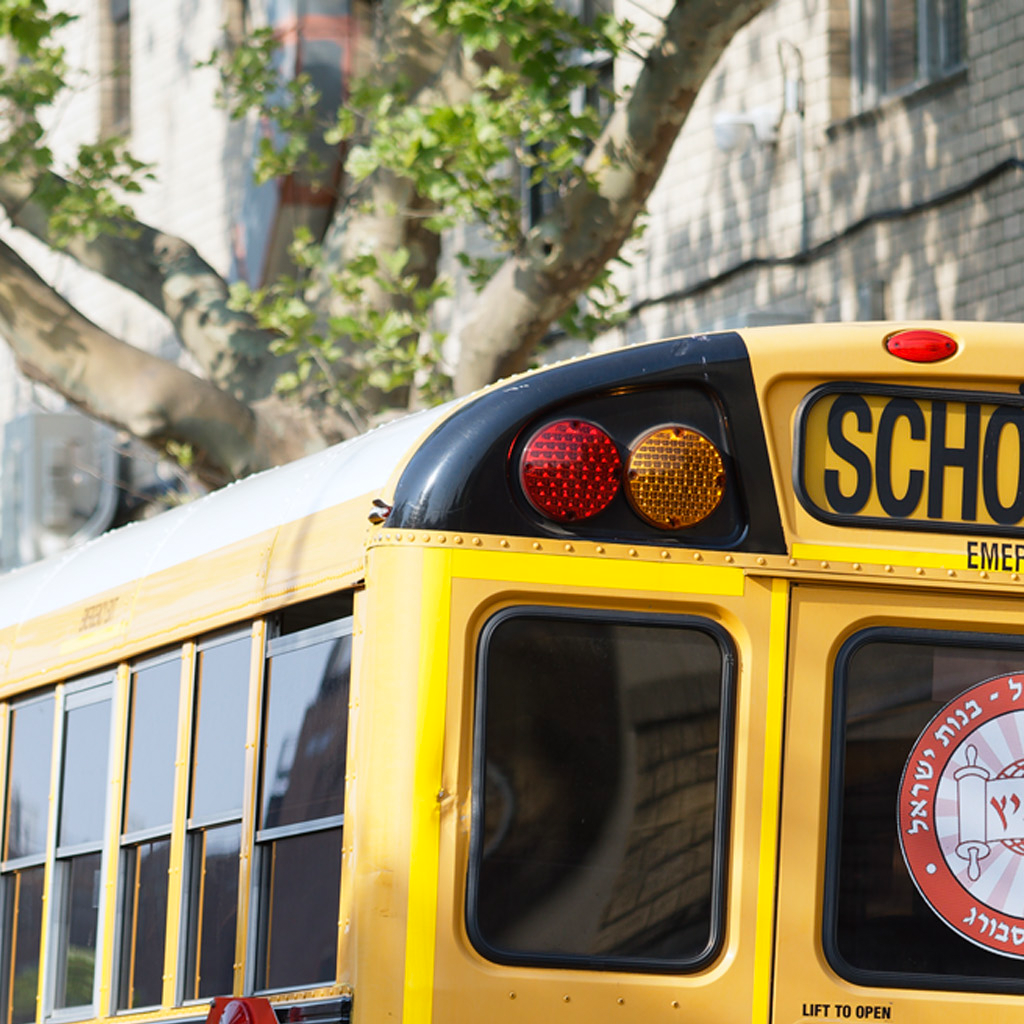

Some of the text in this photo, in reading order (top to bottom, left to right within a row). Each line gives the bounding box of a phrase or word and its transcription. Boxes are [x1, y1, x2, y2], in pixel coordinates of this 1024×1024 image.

[824, 394, 1024, 525] SCHO
[934, 699, 983, 748] בנות
[907, 749, 936, 836] ישראל
[802, 1003, 891, 1019] LIFT TO OPEN
